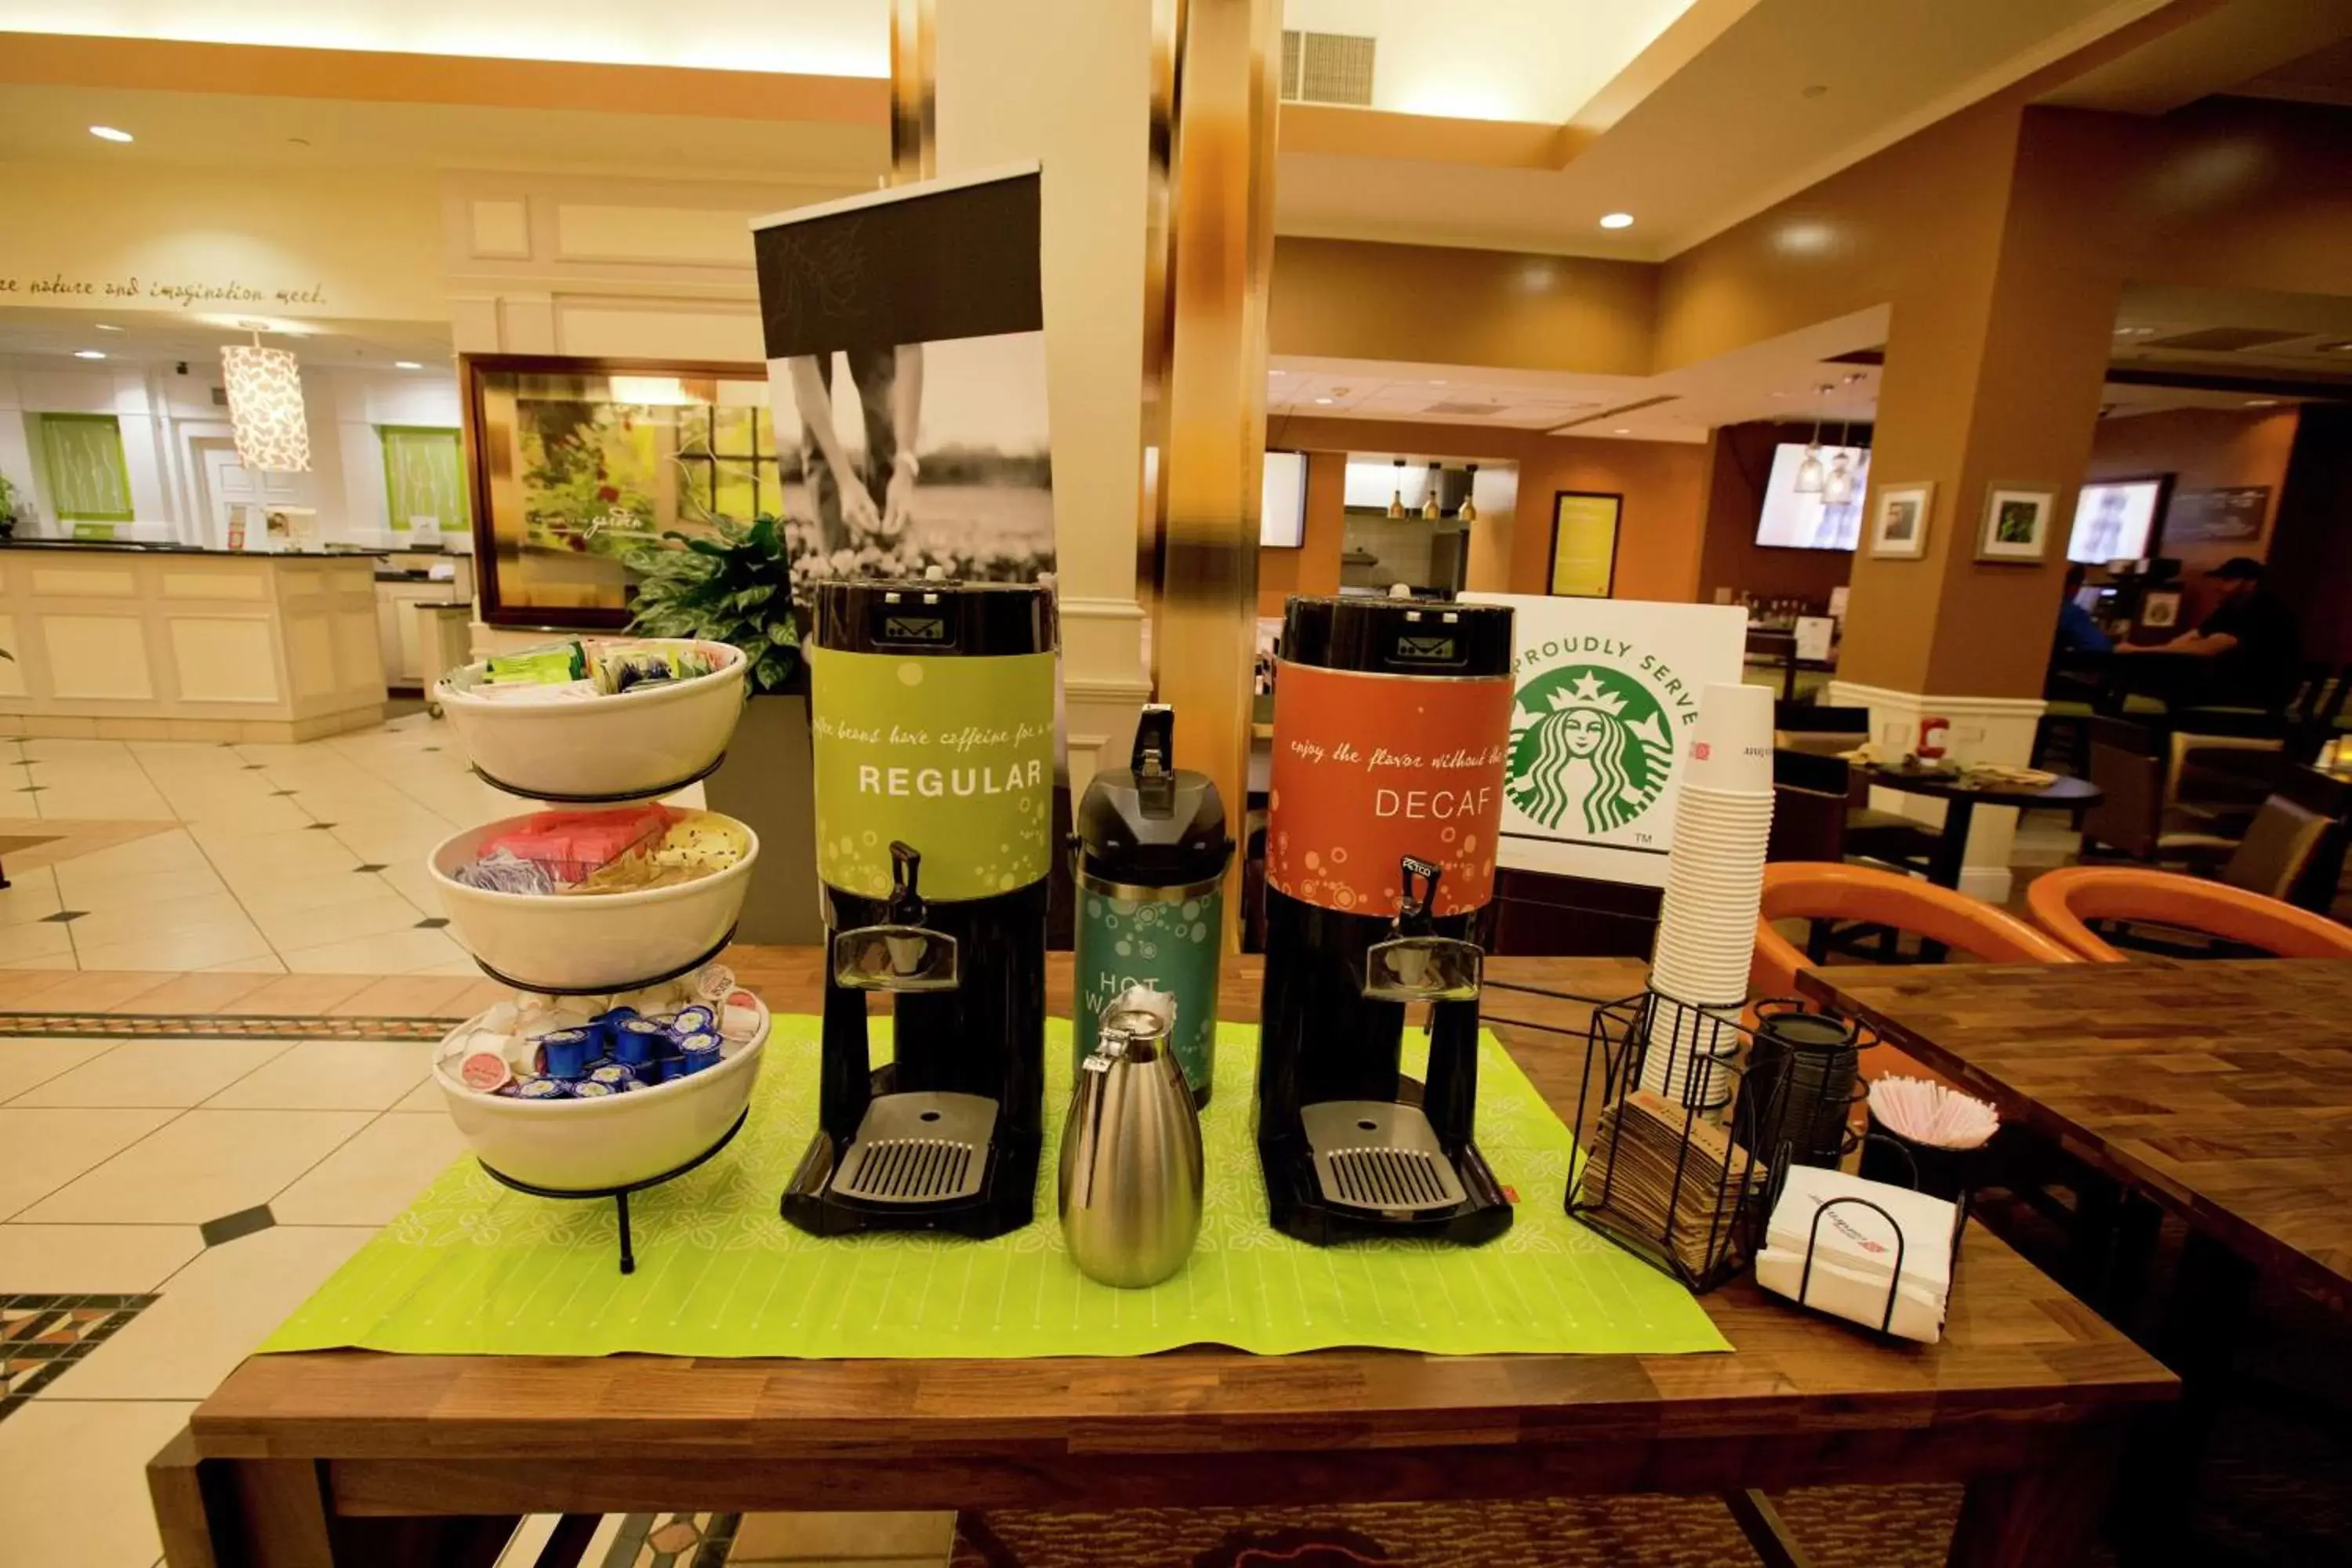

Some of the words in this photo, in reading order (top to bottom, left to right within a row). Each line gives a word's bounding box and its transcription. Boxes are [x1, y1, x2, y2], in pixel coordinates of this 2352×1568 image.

[31, 274, 93, 294] nature
[104, 276, 140, 296] and
[150, 280, 263, 307] imagination
[1639, 654, 1699, 726] SERVE
[837, 720, 881, 743] beans
[889, 724, 931, 745] have
[940, 726, 1008, 753] caffeine
[1014, 722, 1036, 748] for
[1291, 739, 1324, 763] enjoy
[1333, 742, 1360, 762] the
[1367, 747, 1424, 772] flavor
[1432, 747, 1487, 769] without
[858, 759, 1041, 797] REGULAR
[1375, 786, 1491, 818] DECAF
[1635, 833, 1653, 844] TM
